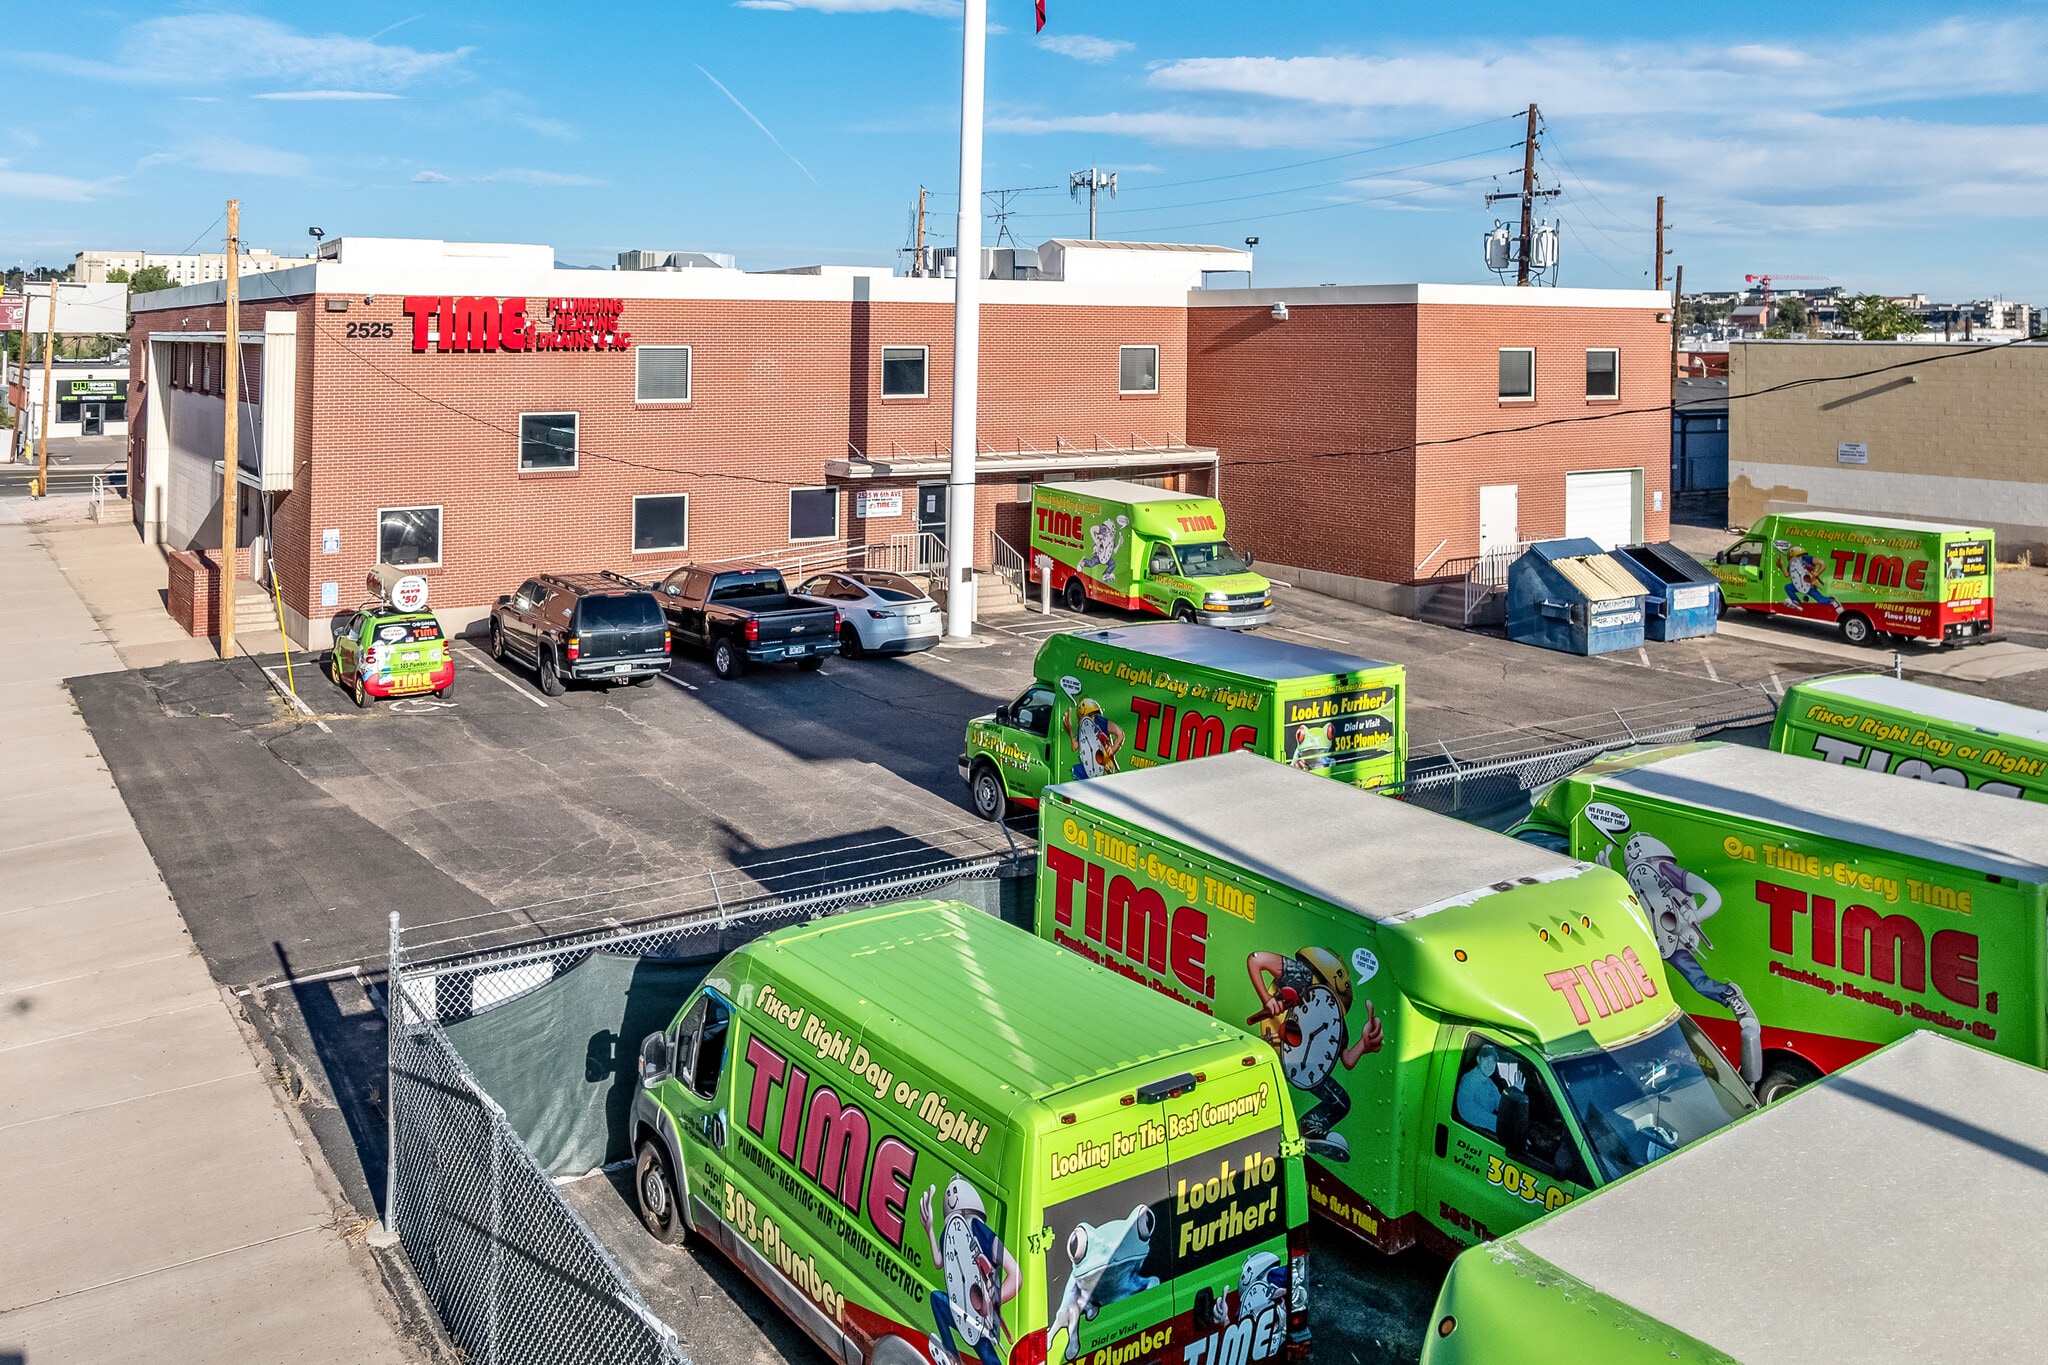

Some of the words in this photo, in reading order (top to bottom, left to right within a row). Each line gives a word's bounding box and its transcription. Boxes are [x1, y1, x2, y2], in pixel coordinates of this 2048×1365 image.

[549, 297, 624, 313] PLUMBING
[346, 322, 394, 339] 2525
[403, 296, 527, 351] TIME
[555, 314, 618, 331] HEATING
[539, 332, 594, 348] DRAINS
[597, 331, 608, 348] &
[612, 332, 631, 348] AC
[1036, 506, 1084, 542] TIME
[1785, 526, 1814, 538] Fixed
[1816, 528, 1846, 543] Right
[1847, 532, 1871, 545] Day
[1887, 538, 1923, 550] Night!
[1830, 549, 1929, 591] TIME
[1947, 580, 1983, 601] TIME
[1874, 602, 1904, 612] PROBLEM
[1905, 606, 1932, 617] SOLVED!
[413, 628, 439, 638] TIME
[393, 672, 433, 689] TIME
[1075, 653, 1114, 675] Fixed
[1115, 661, 1153, 687] Right
[1154, 672, 1189, 699] Day
[1191, 683, 1210, 699] or
[1212, 685, 1263, 713] Night!
[1291, 701, 1320, 722] Look
[1322, 701, 1338, 717] No
[1341, 691, 1387, 713] Further!
[1344, 722, 1358, 732] Dial
[1359, 722, 1365, 730] or
[1365, 718, 1381, 729] Visit
[1335, 730, 1390, 751] 303-Plumber
[1806, 704, 1859, 729] Fixed
[1859, 717, 1910, 742] Right
[1910, 729, 1955, 757] Day
[1956, 745, 1979, 761] or
[1979, 748, 2048, 778] Night!
[1600, 815, 1613, 824] FIRST
[1610, 810, 1626, 819] RIGHT
[1062, 817, 1089, 851] On
[1093, 828, 1138, 871] TIME
[1147, 853, 1199, 904] Every
[1203, 875, 1256, 923] TIME
[1638, 867, 1648, 875] 12
[1723, 836, 1756, 863] On
[1762, 844, 1820, 879] TIME
[1832, 862, 1899, 904] Every
[1905, 878, 1973, 915] TIME
[1631, 879, 1641, 887] 11
[1046, 843, 1209, 997] TIME
[1755, 879, 1980, 1010] TIME
[1543, 945, 1658, 1026] TIME
[1769, 960, 1836, 995] Plumbing
[1842, 981, 1904, 1016] Heating
[1911, 1001, 1965, 1031] Drains
[1325, 995, 1336, 1009] 12
[755, 983, 806, 1031] Fixed
[801, 1012, 852, 1067] Right
[848, 1043, 894, 1100] Day
[894, 1080, 920, 1110] or
[917, 1090, 990, 1155] Night!
[1051, 1140, 1111, 1181] Looking
[1112, 1130, 1137, 1159] For
[1138, 1119, 1166, 1150] The
[1167, 1107, 1199, 1141] Best
[1200, 1081, 1269, 1129] Company?
[744, 1031, 920, 1253] TIME
[1456, 1140, 1483, 1157] Dial
[1453, 1155, 1481, 1175] Visit
[1464, 1152, 1474, 1160] or
[704, 1161, 724, 1186] Dial
[1176, 1159, 1238, 1217] Look
[1243, 1151, 1276, 1190] No
[708, 1180, 716, 1192] or
[702, 1184, 722, 1211] Visit
[738, 1136, 777, 1180] PLUMBING
[778, 1172, 814, 1212] HEATING
[816, 1200, 833, 1229] AIR
[836, 1218, 872, 1261] DRAINS
[875, 1251, 924, 1303] ELECTRIC
[953, 1221, 962, 1232] 12
[1178, 1187, 1279, 1259] Further!
[1351, 1207, 1378, 1237] TIME
[947, 1234, 956, 1246] 11
[722, 1180, 845, 1325] 303-Plumber
[903, 1242, 922, 1269] INC
[946, 1251, 955, 1262] 10
[948, 1272, 953, 1283] 9
[974, 1275, 980, 1284] 3
[1249, 1287, 1258, 1297] 12
[975, 1316, 981, 1326] 5
[967, 1328, 973, 1338] 6
[1091, 1334, 1110, 1349] Dial
[1110, 1332, 1118, 1340] or
[1118, 1322, 1139, 1337] Visit
[1183, 1307, 1275, 1365] TIME
